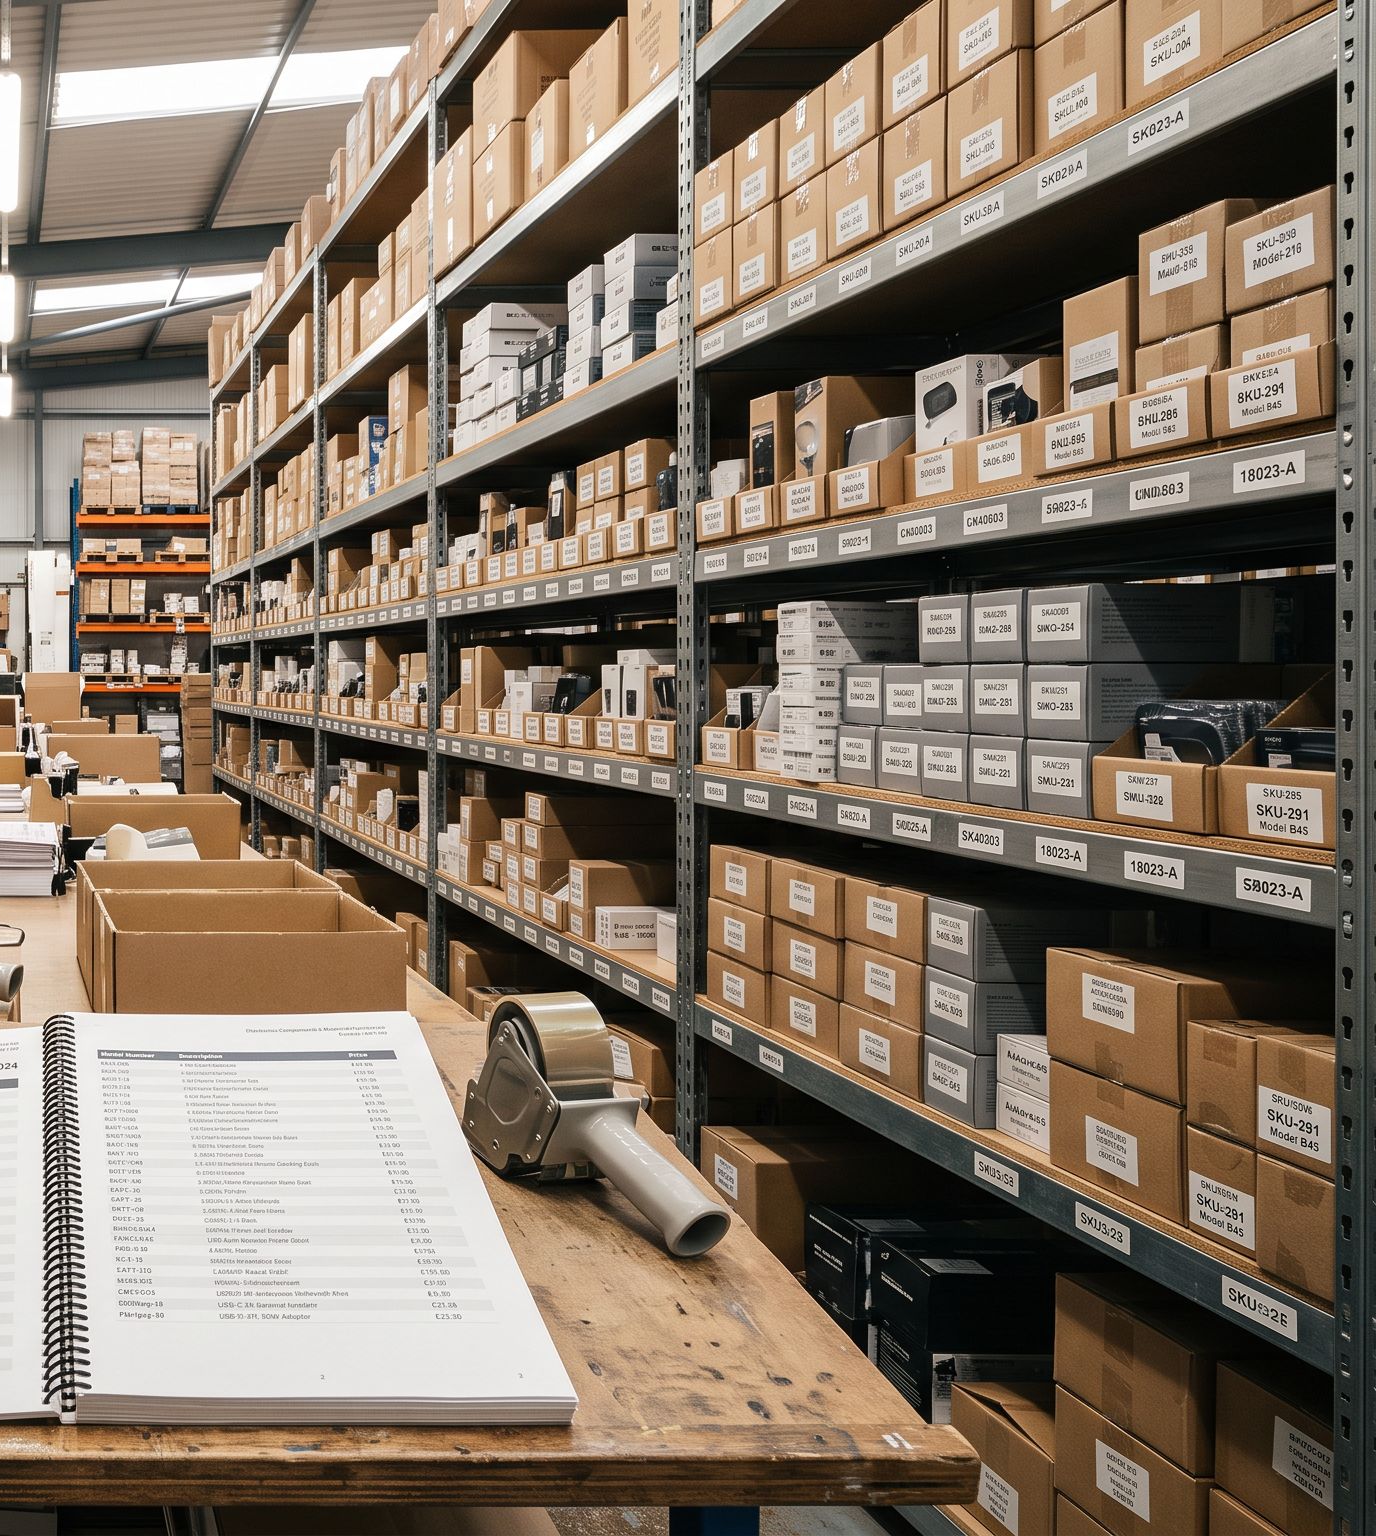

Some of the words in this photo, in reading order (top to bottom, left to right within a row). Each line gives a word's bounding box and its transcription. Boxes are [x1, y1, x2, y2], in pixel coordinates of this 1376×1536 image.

[1240, 460, 1296, 483] 18023-A
[1256, 804, 1309, 822] SKU-291
[1259, 821, 1286, 833] Model
[1040, 845, 1081, 863] 18023-A
[1130, 860, 1178, 880] 18023-A
